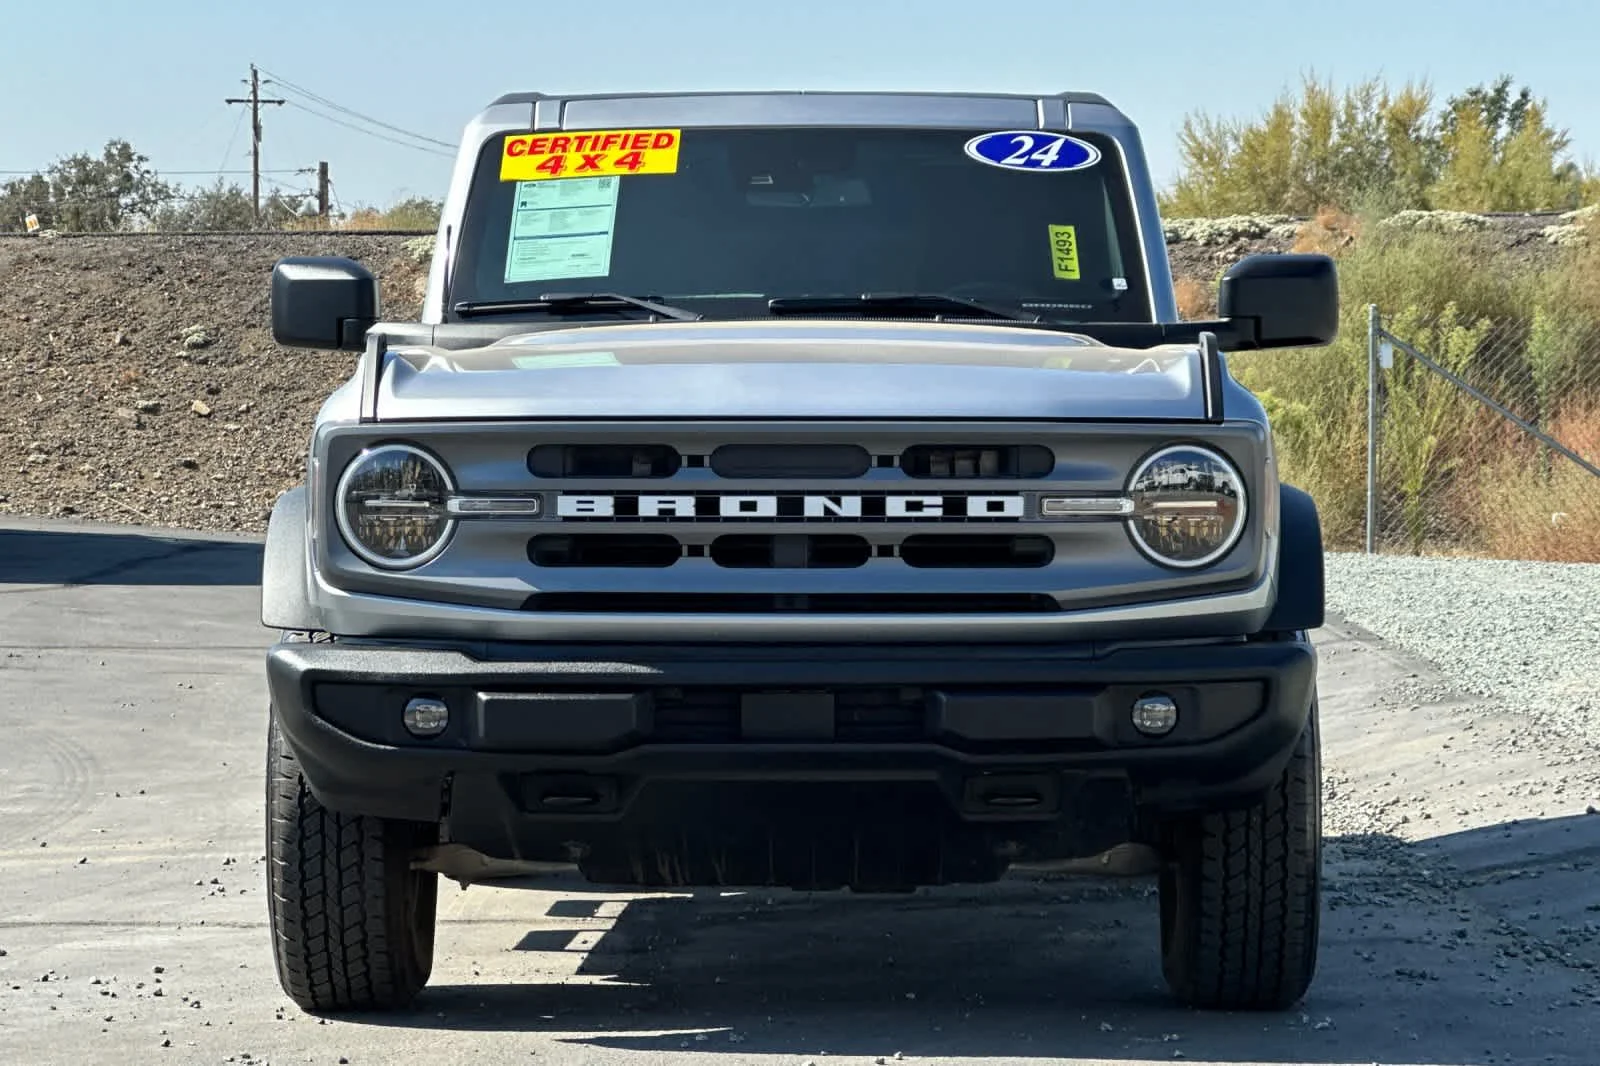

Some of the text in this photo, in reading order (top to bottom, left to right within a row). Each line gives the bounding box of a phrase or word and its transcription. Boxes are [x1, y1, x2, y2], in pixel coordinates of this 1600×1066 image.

[506, 132, 675, 157] CERTIFIED
[1000, 135, 1067, 167] 24
[536, 154, 566, 176] 4
[614, 151, 645, 172] 4
[1055, 231, 1076, 273] F1493
[557, 495, 1025, 517] BRONCO
